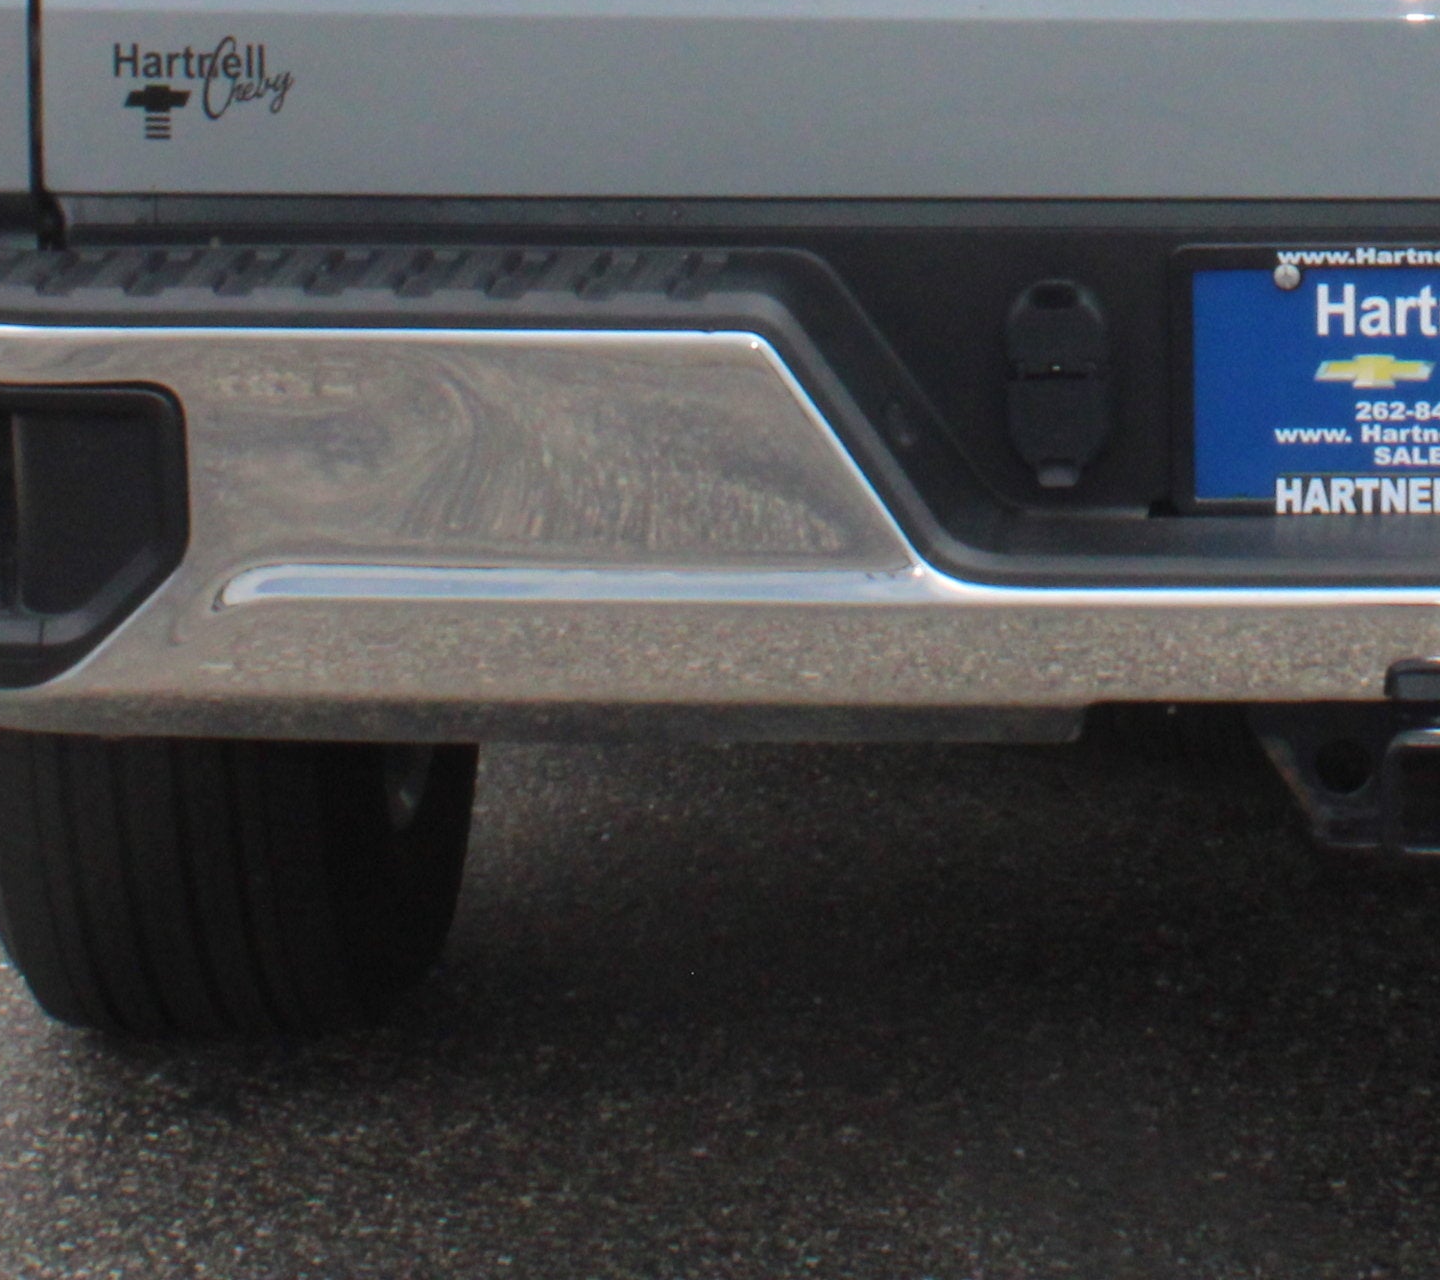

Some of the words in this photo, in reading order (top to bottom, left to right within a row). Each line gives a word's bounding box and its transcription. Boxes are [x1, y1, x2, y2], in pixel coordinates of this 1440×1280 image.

[114, 41, 265, 79] Hartnell
[203, 34, 295, 121] Chevy
[1274, 427, 1353, 444] www.
